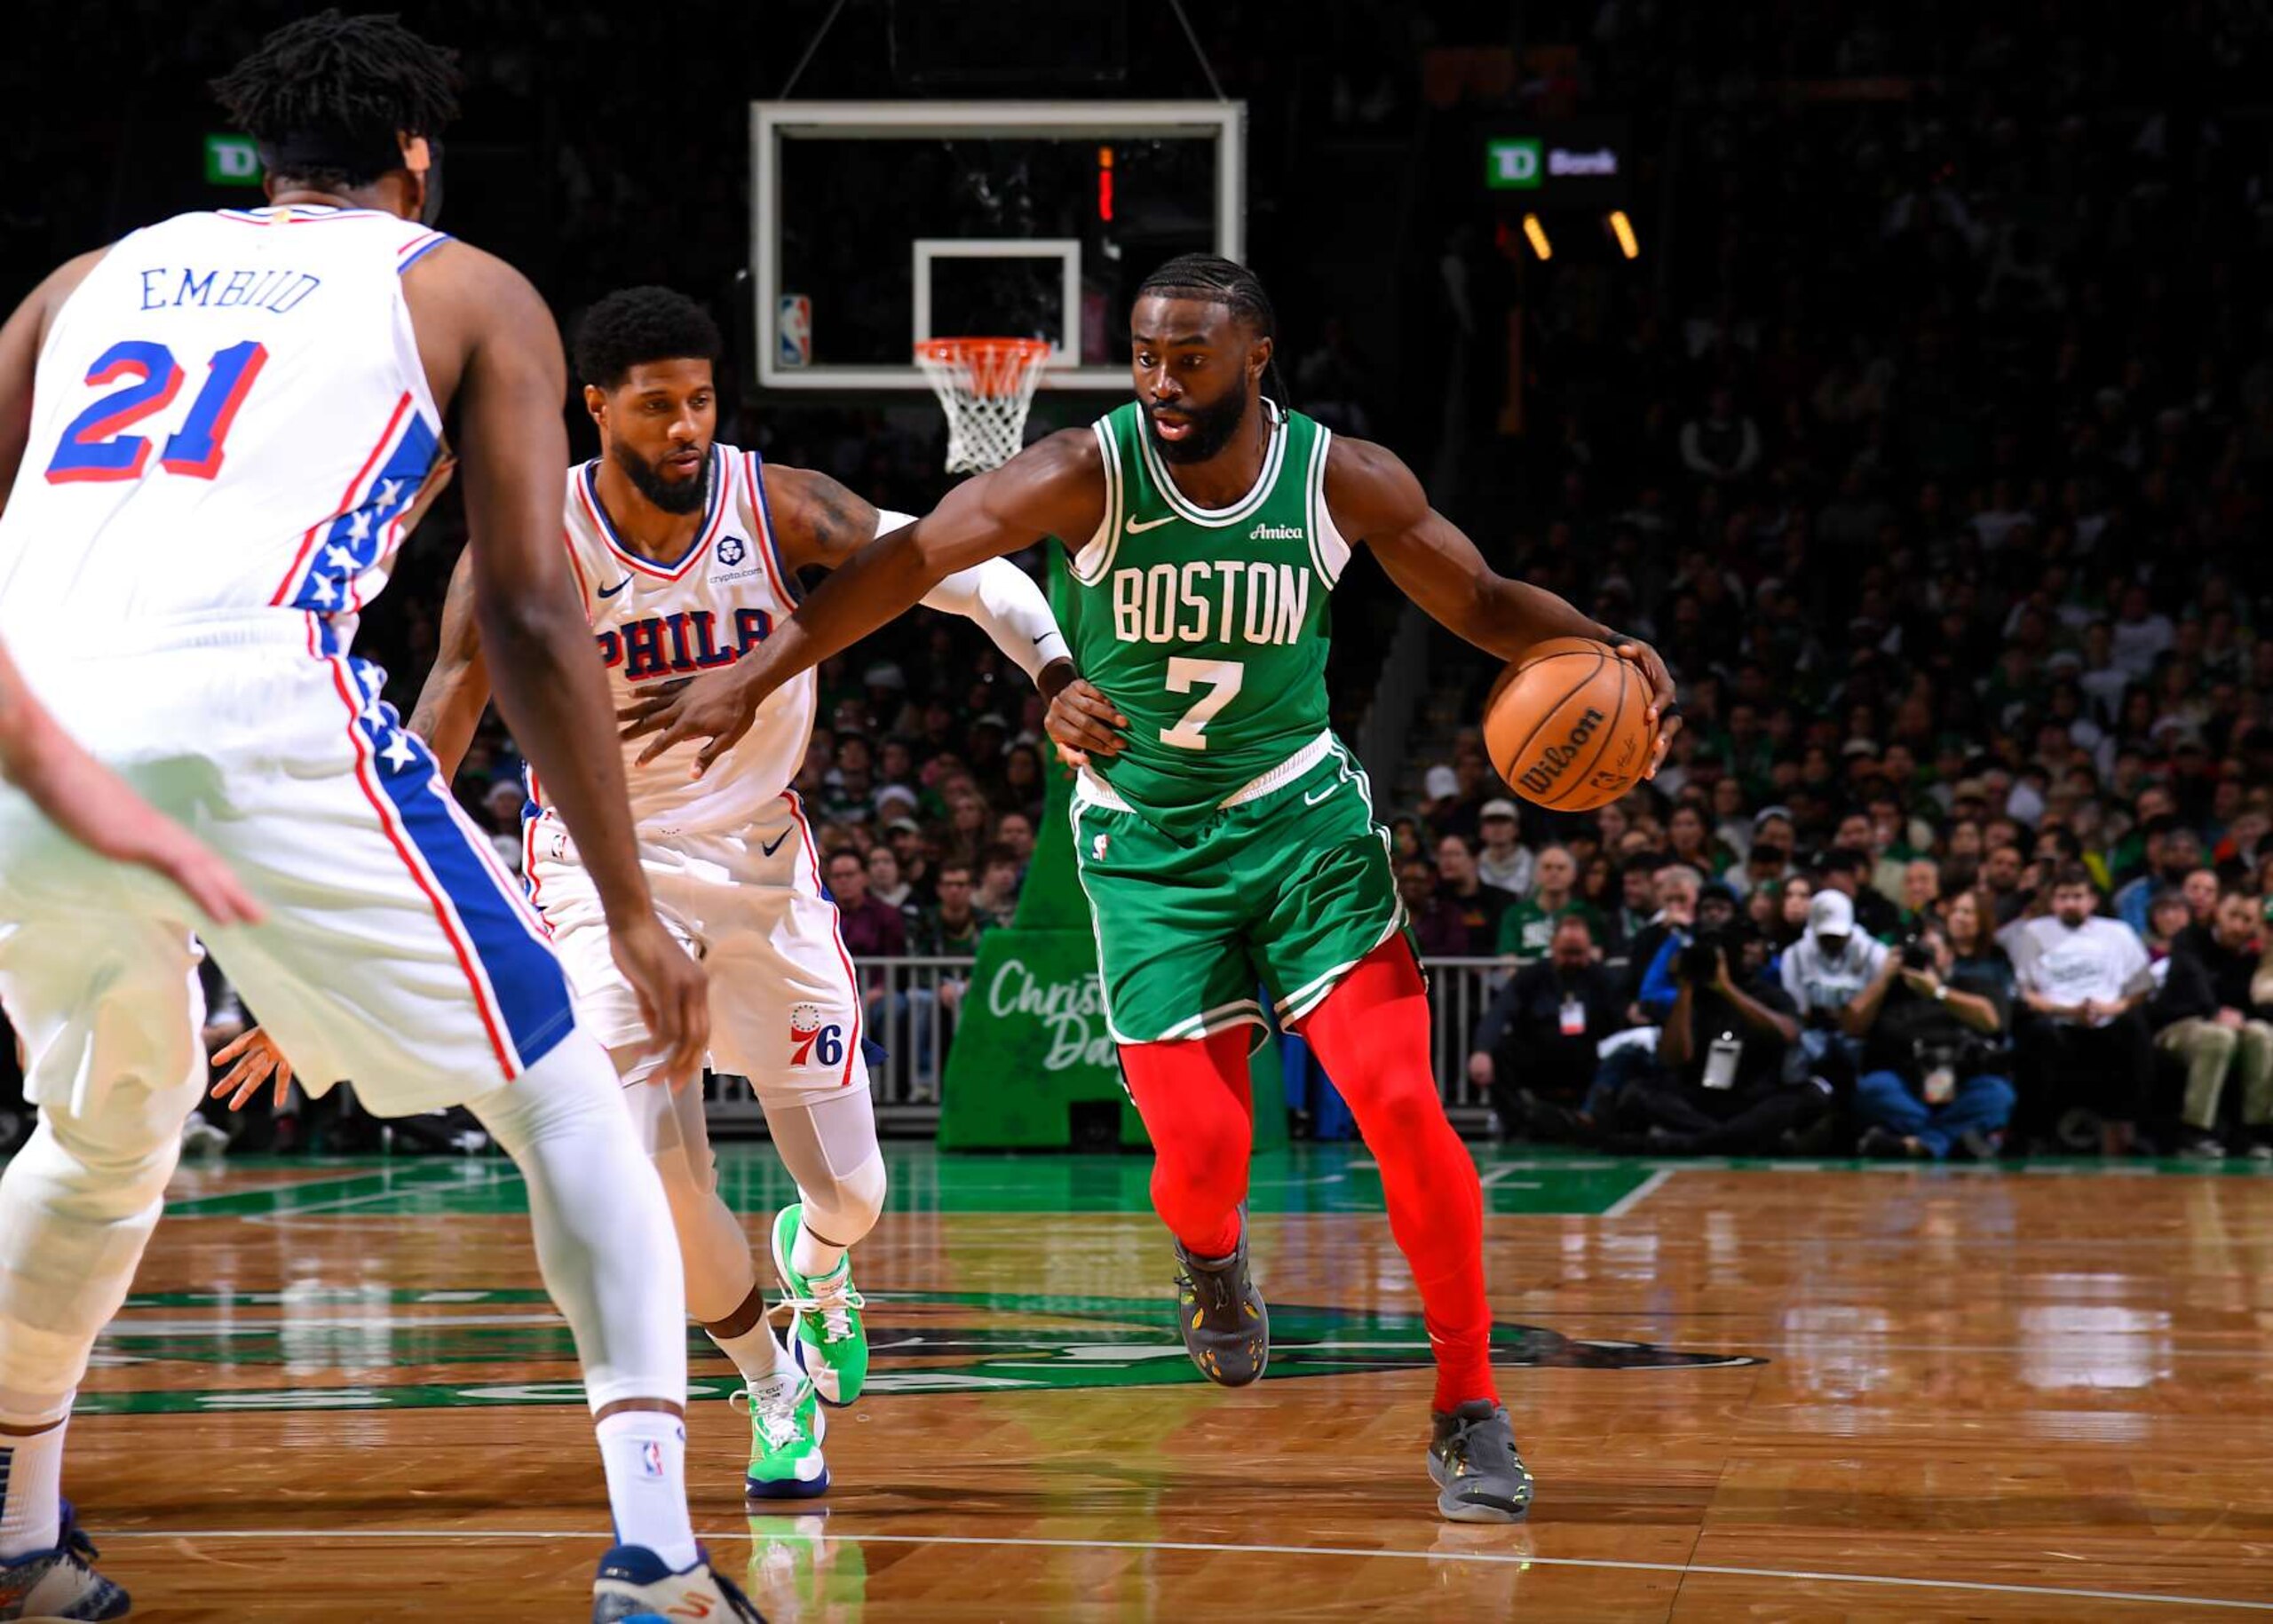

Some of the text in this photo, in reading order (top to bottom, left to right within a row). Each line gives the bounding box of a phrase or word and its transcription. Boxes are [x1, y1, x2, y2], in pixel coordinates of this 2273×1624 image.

[212, 143, 257, 177] TD
[1491, 147, 1536, 178] TD
[139, 268, 321, 313] EMBIID
[44, 340, 269, 485] 21
[1249, 523, 1303, 540] Amica
[709, 567, 763, 584] crypto.com
[1113, 560, 1310, 646] BOSTON
[1160, 656, 1244, 750] 7
[1519, 708, 1604, 795] Wilson
[790, 1024, 843, 1066] 76
[1042, 1011, 1124, 1086] Da
